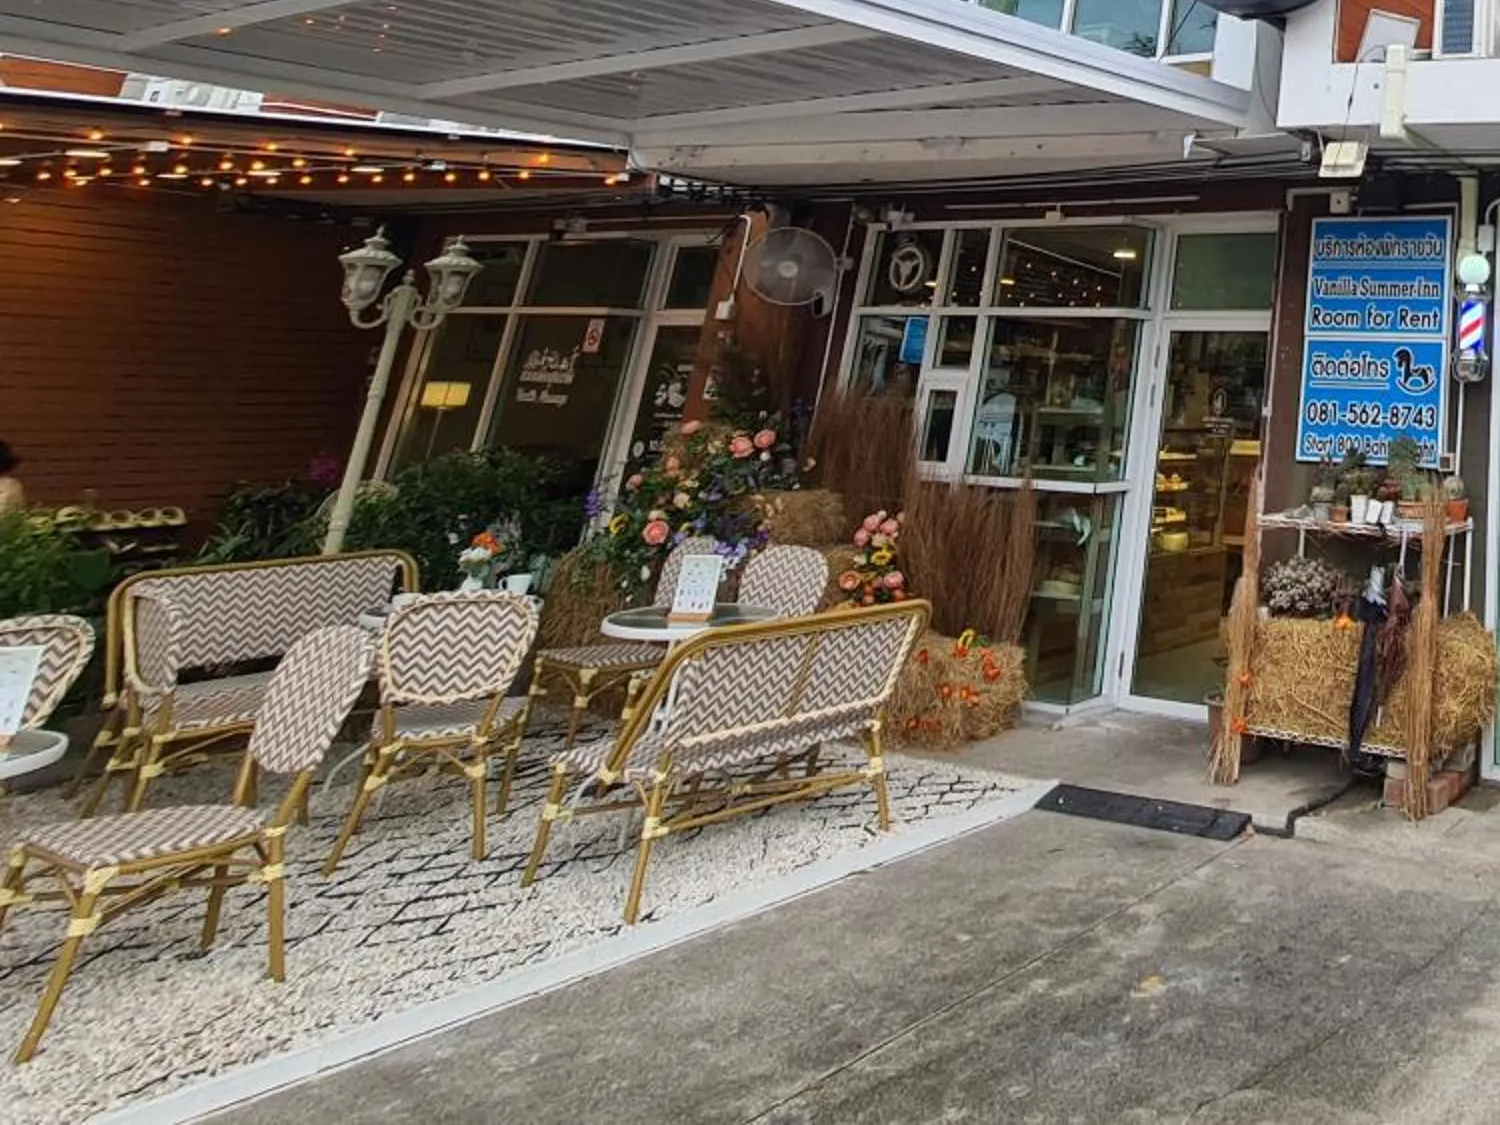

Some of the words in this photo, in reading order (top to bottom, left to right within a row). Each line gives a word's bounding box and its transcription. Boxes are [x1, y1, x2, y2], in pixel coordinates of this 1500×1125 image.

[1314, 233, 1444, 260] บริการห้องพักรายวัน
[1313, 277, 1358, 297] Vanilla
[1359, 277, 1414, 297] Summer
[1311, 306, 1360, 327] Room
[1366, 304, 1394, 327] for
[1398, 307, 1440, 329] Rent
[1310, 350, 1391, 379] ติดต่อโทร
[1307, 402, 1437, 429] 081-562-8743
